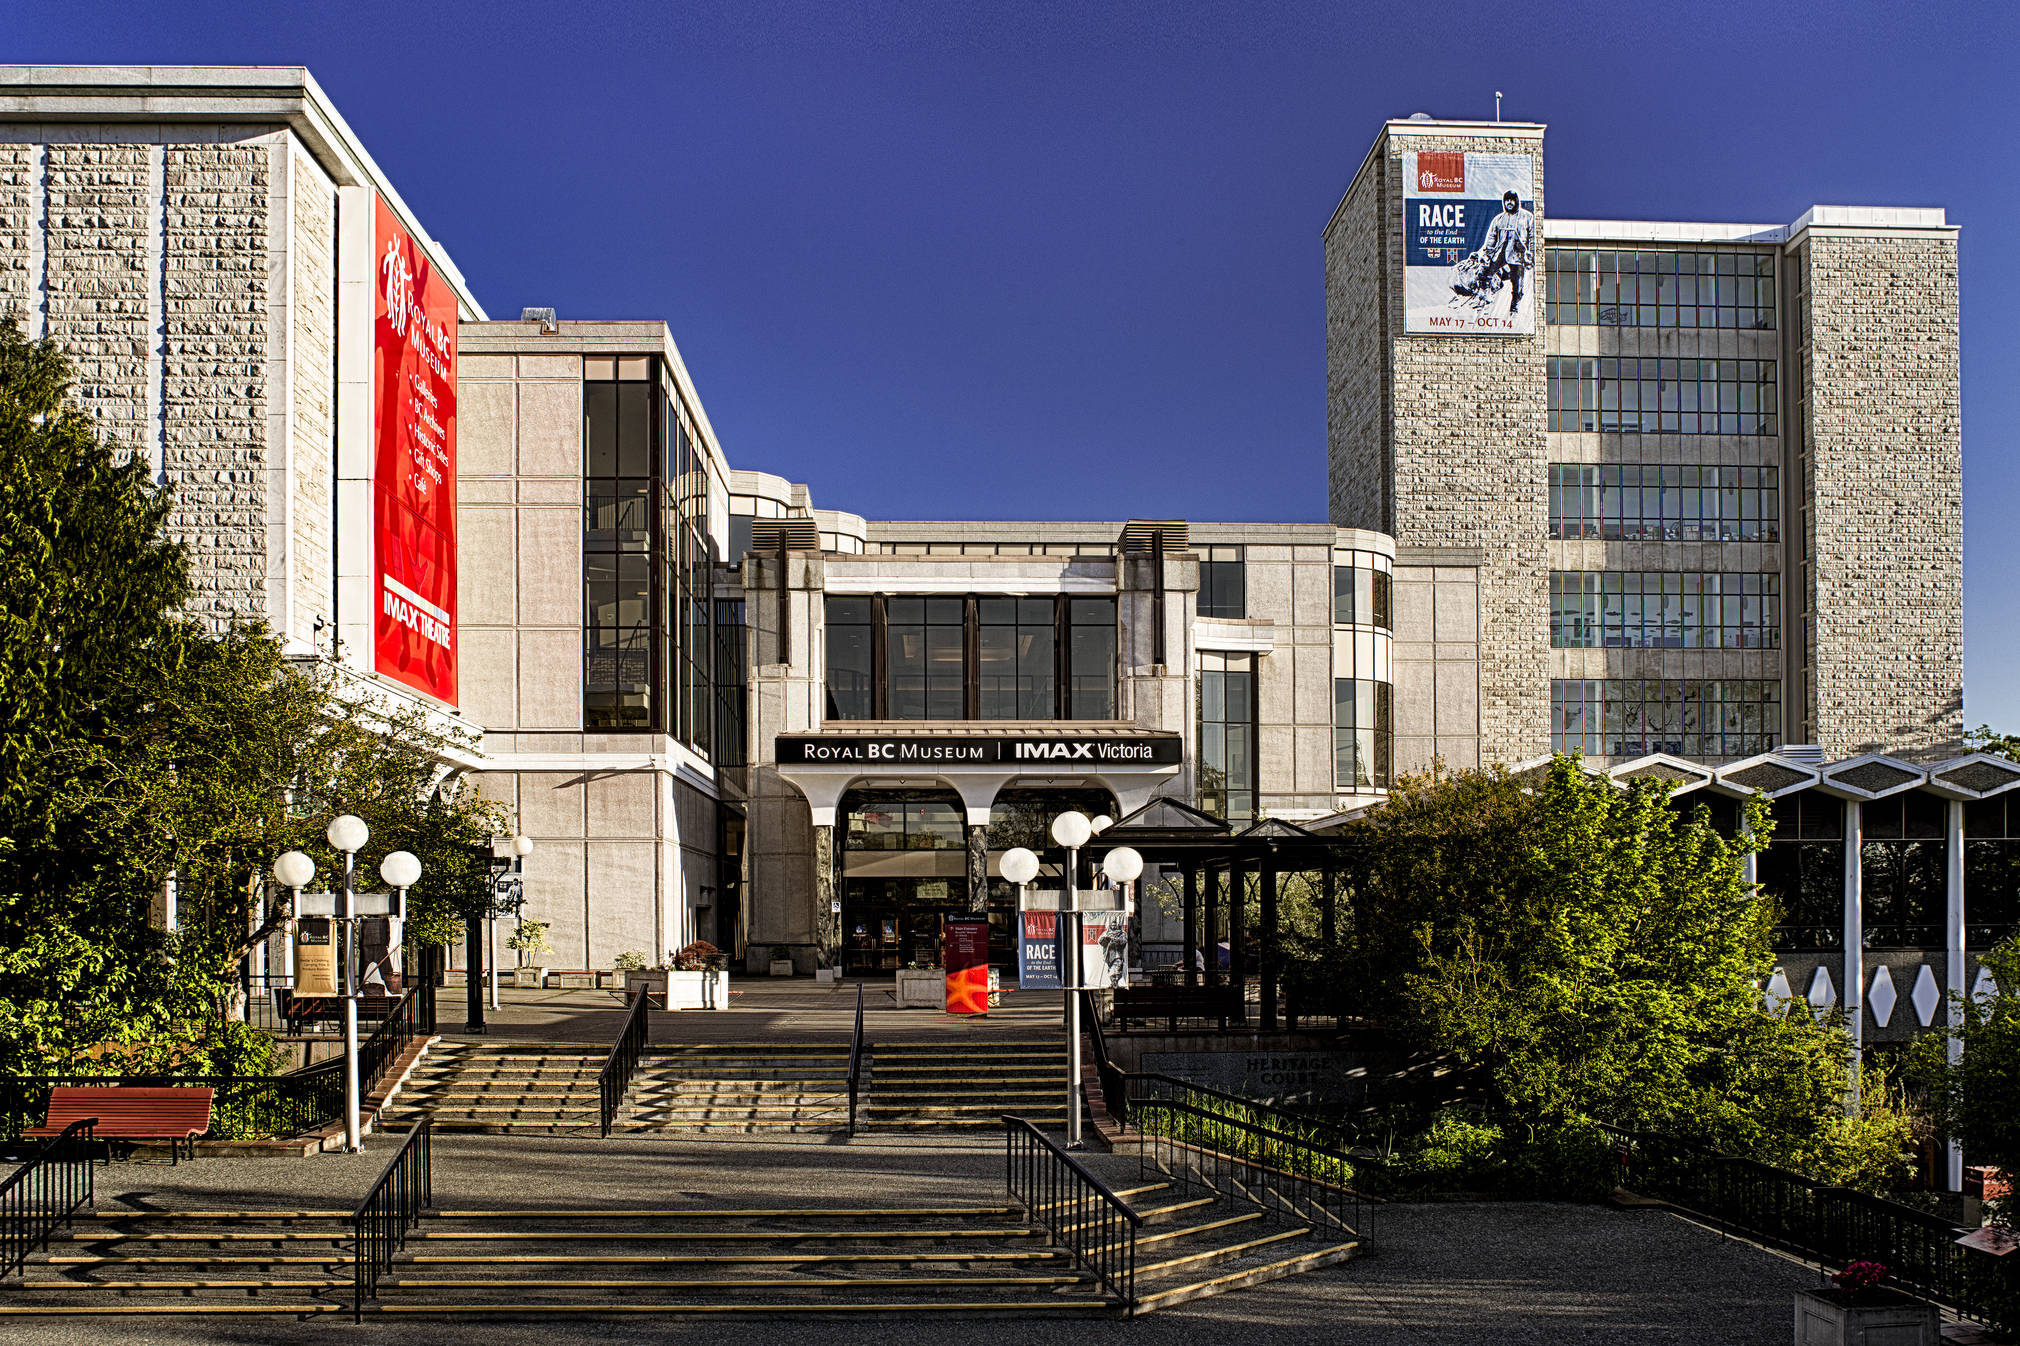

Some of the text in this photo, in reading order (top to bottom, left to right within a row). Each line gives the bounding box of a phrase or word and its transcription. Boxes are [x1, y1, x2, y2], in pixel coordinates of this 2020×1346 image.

[1419, 204, 1465, 227] RACE
[1420, 236, 1465, 244] OF THE EARTH
[407, 290, 450, 360] ROYAL BC
[1429, 317, 1451, 326] MAY
[1455, 320, 1465, 328] 17
[1477, 317, 1499, 327] OCT
[1502, 320, 1513, 329] 14
[411, 324, 447, 382] MUSEUM
[415, 374, 437, 408] Galleries
[415, 398, 445, 440] BC Archives
[415, 422, 436, 455] Historic
[384, 590, 451, 650] IMAX THEATRE
[804, 743, 1152, 759] ROYAL BC MUSEUM IMAX Victoria
[1026, 944, 1056, 960] RACE
